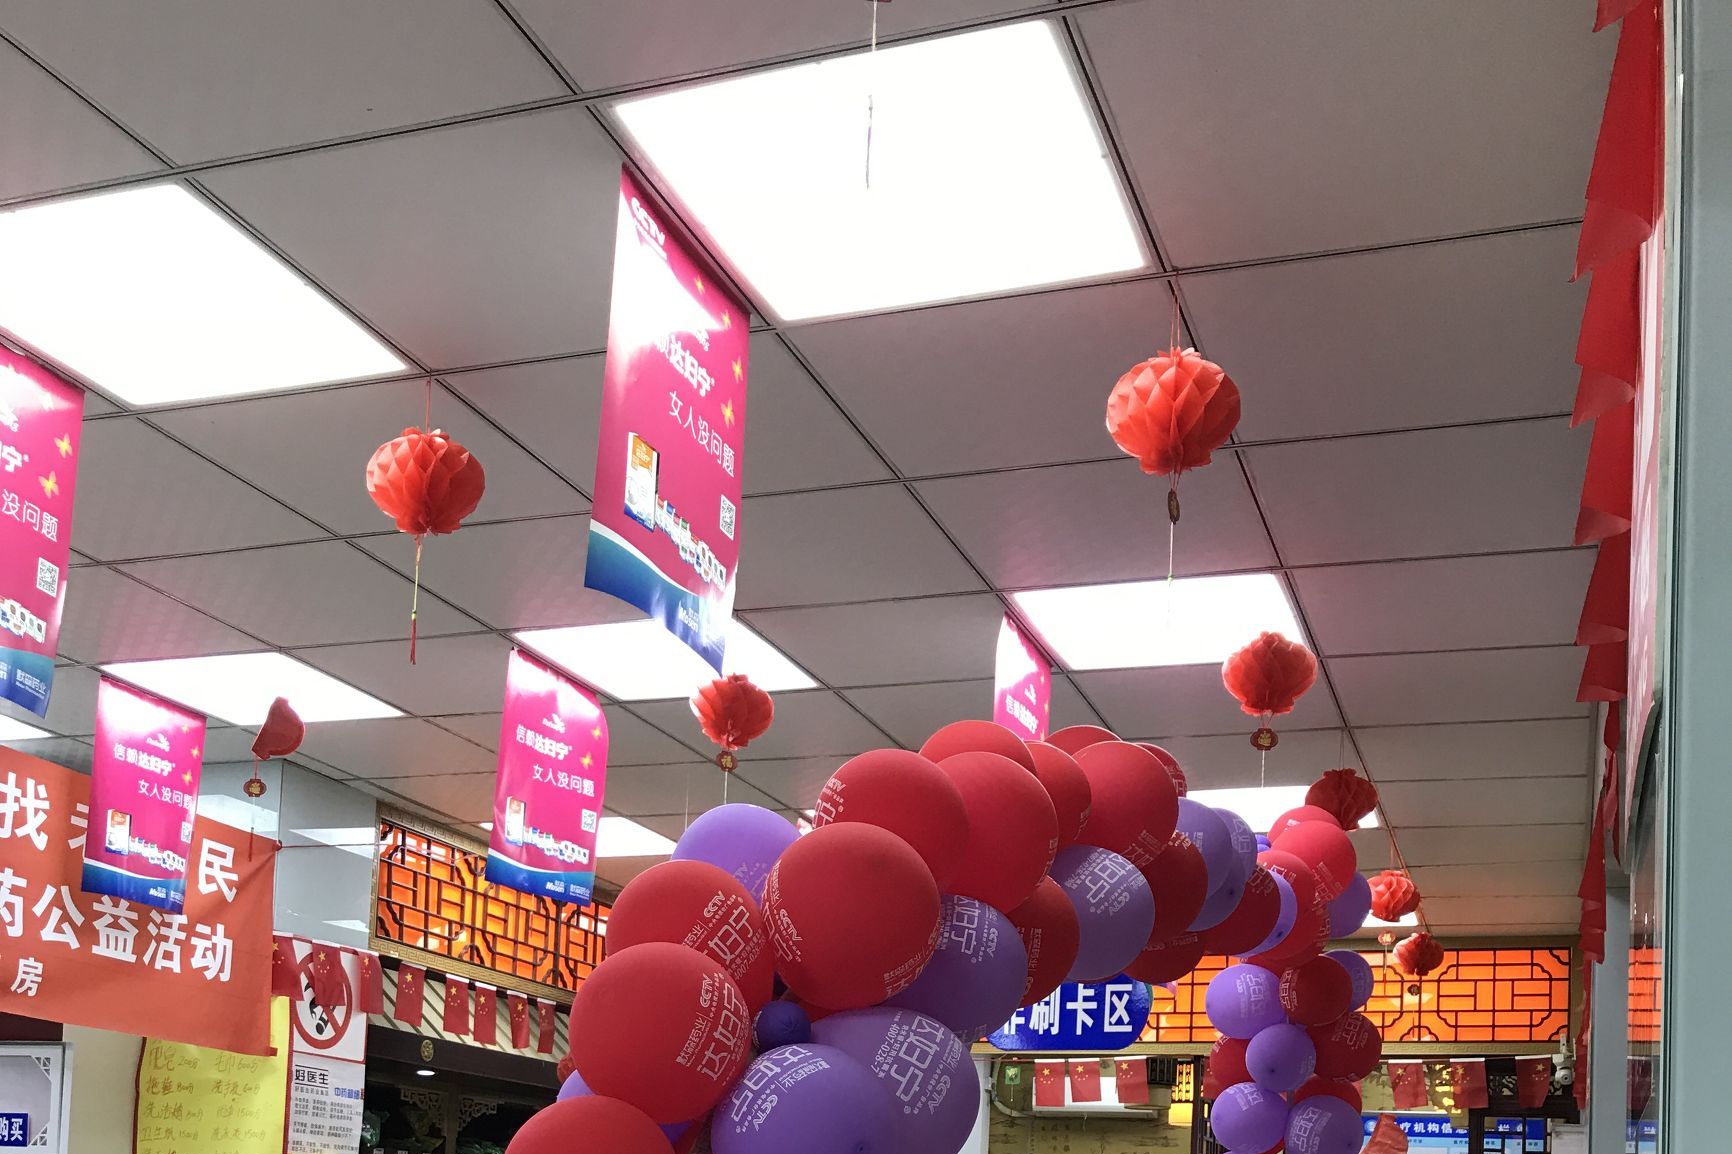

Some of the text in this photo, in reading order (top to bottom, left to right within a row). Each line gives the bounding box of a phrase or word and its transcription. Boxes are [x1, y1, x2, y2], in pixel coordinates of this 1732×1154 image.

[669, 391, 735, 477] 女人没问题
[1, 488, 59, 543] 没问题
[113, 742, 172, 777] 信赖达妇宁
[516, 724, 569, 761] 信赖达妇宁
[138, 779, 195, 811] 女人没问题
[532, 763, 595, 798] 女人没问题
[703, 890, 725, 918] CCTV
[703, 905, 754, 964] 妇宁
[780, 909, 802, 940] CCTV
[11, 957, 44, 997] 房
[699, 973, 713, 1008] CCTV
[697, 982, 743, 1081] 达妇宁
[294, 1068, 329, 1085] 好医生
[890, 1016, 945, 1102] 达妇宁
[731, 1045, 813, 1122] 达妇宁
[928, 1075, 951, 1114] CCTV
[753, 1095, 778, 1132] CCTV
